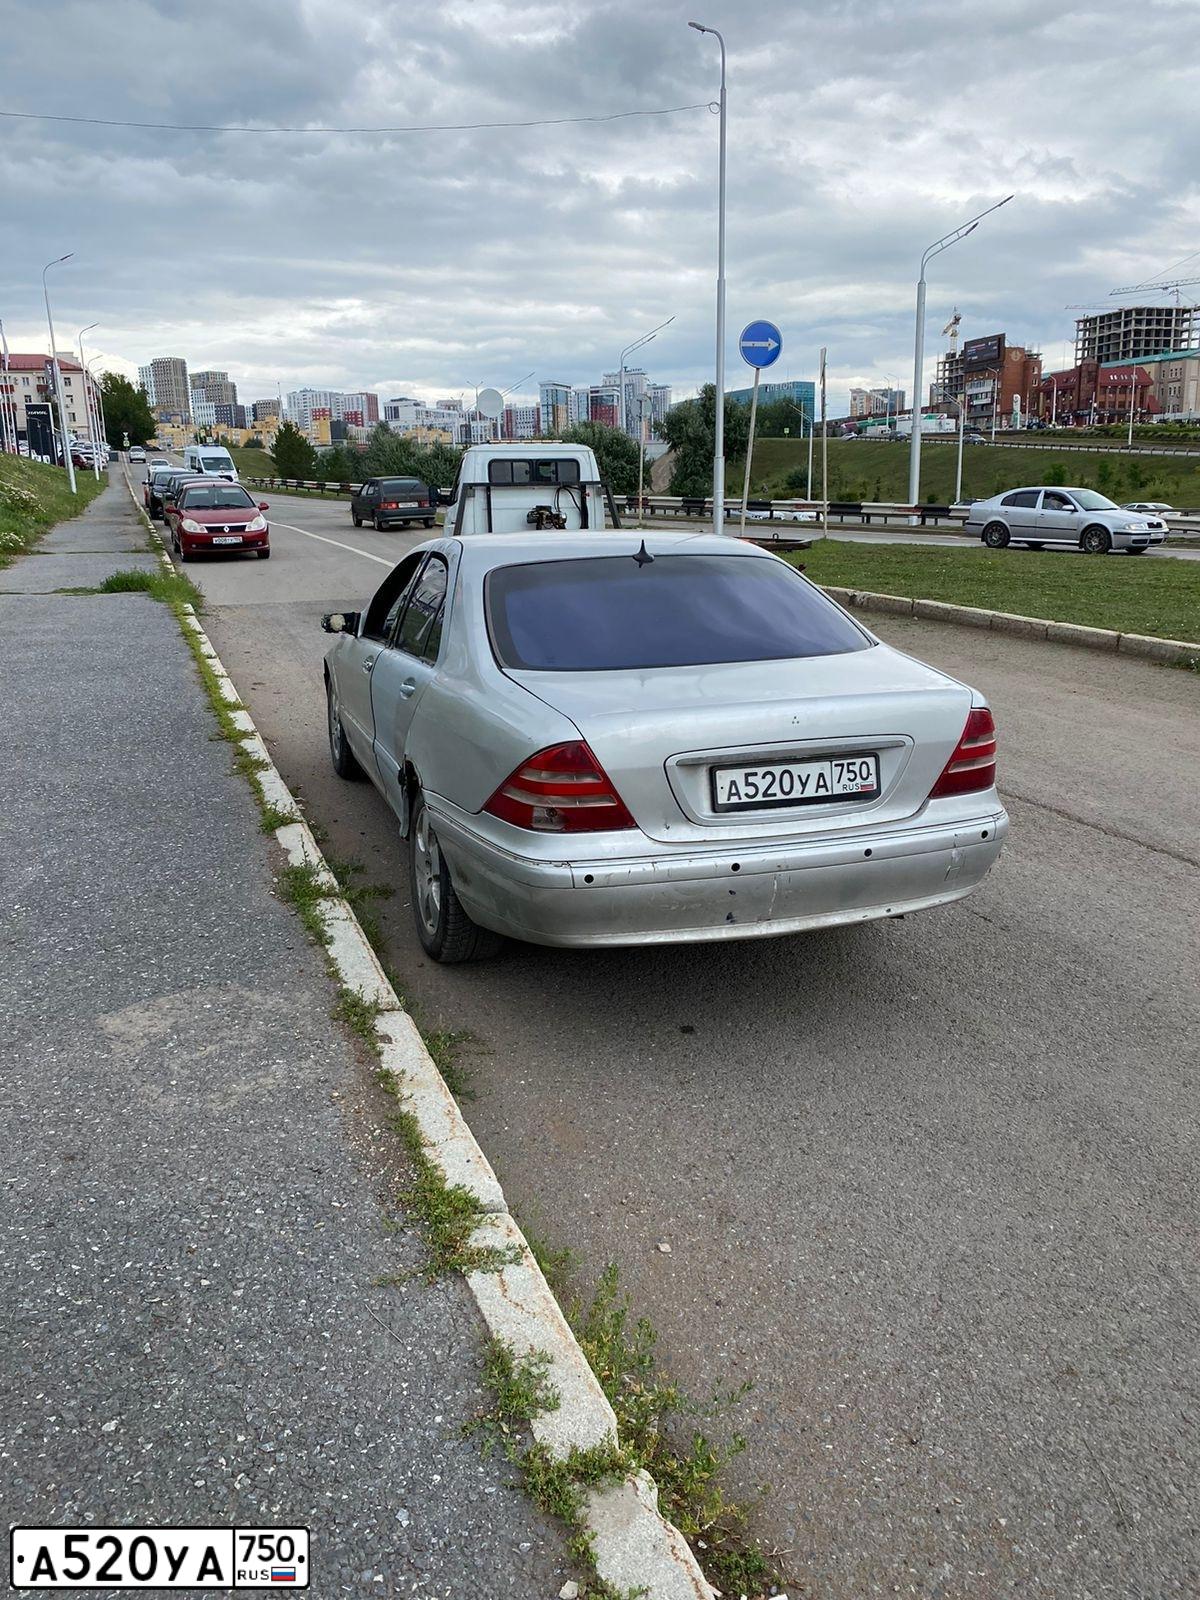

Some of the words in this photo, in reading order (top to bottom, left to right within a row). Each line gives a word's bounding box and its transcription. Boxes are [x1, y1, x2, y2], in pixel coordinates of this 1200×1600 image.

[727, 769, 829, 802] А520УА
[834, 761, 870, 784] 750
[842, 783, 860, 792] RUS
